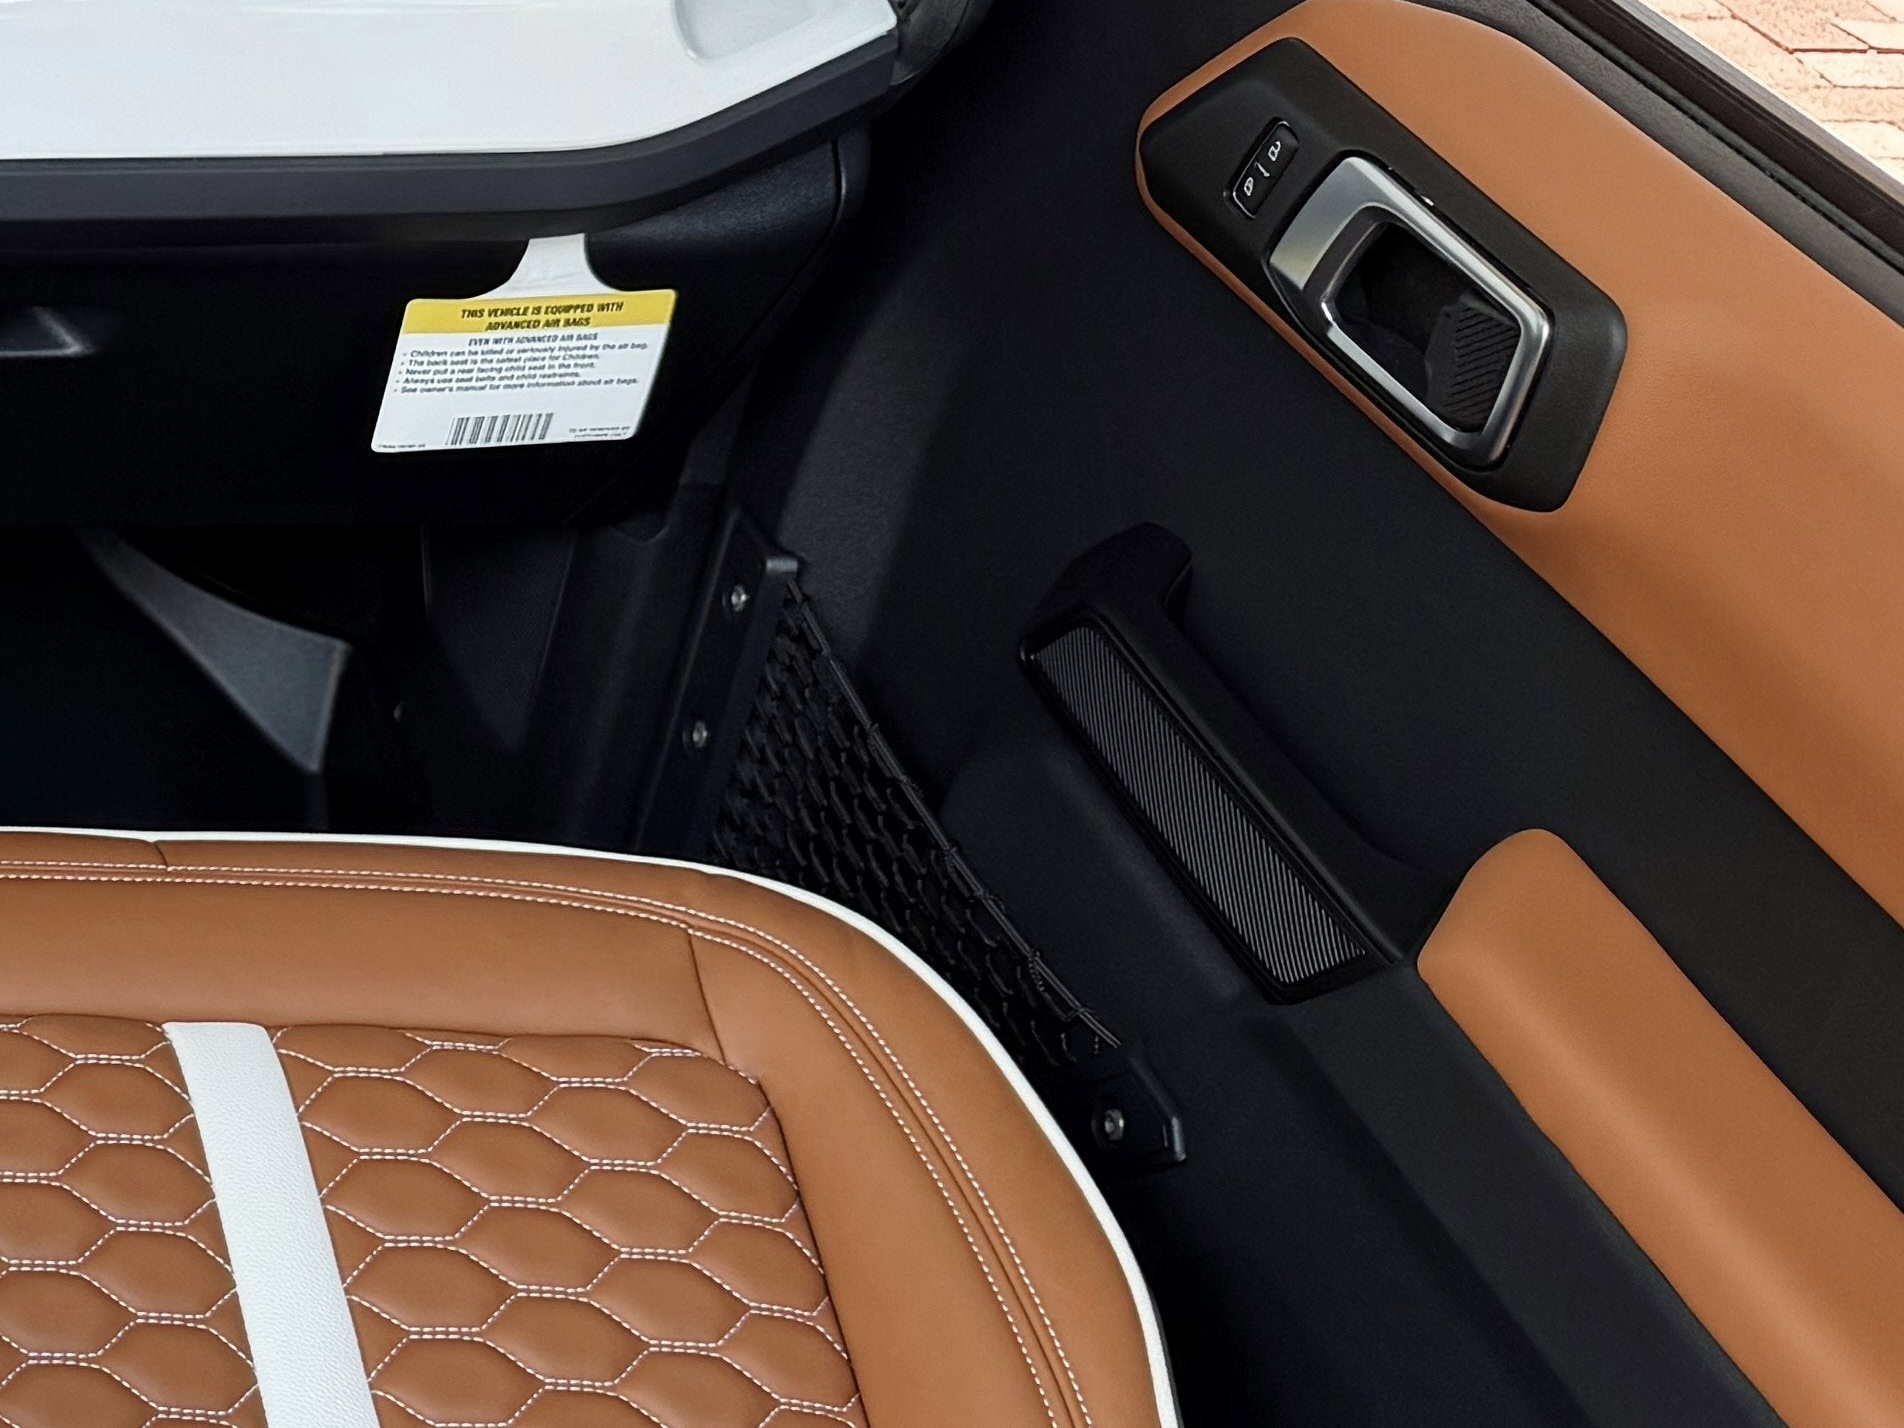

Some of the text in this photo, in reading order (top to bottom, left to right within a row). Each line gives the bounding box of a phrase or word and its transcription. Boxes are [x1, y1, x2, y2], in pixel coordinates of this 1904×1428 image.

[461, 302, 624, 319] THIS VEHICLE IS EQUIPPED WITH
[485, 317, 591, 332] ADVANCED AIR BAGS
